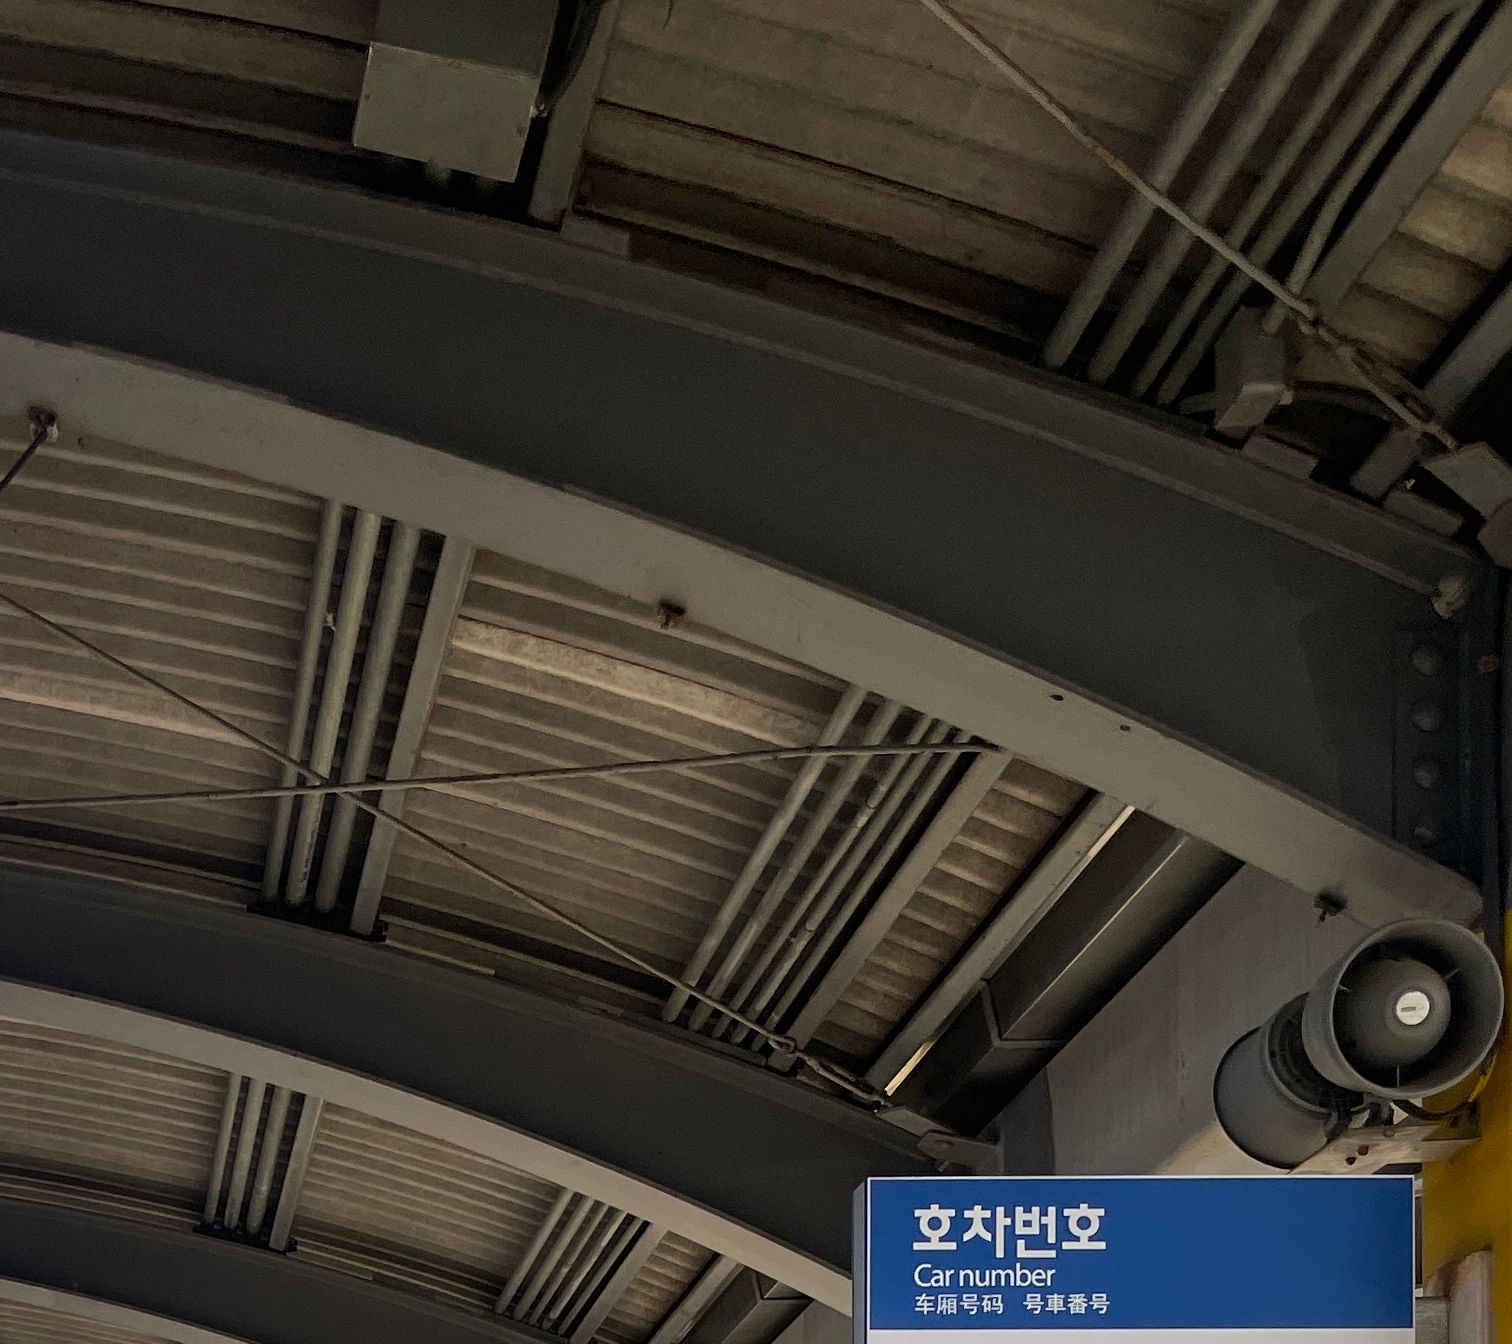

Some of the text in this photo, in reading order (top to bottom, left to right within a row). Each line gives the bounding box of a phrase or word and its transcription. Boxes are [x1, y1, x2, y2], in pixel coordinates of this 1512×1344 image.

[912, 1203, 1107, 1259] 호차번호
[913, 1262, 1057, 1287] Car number
[914, 1293, 1111, 1315] 车厢号码 号車番号
